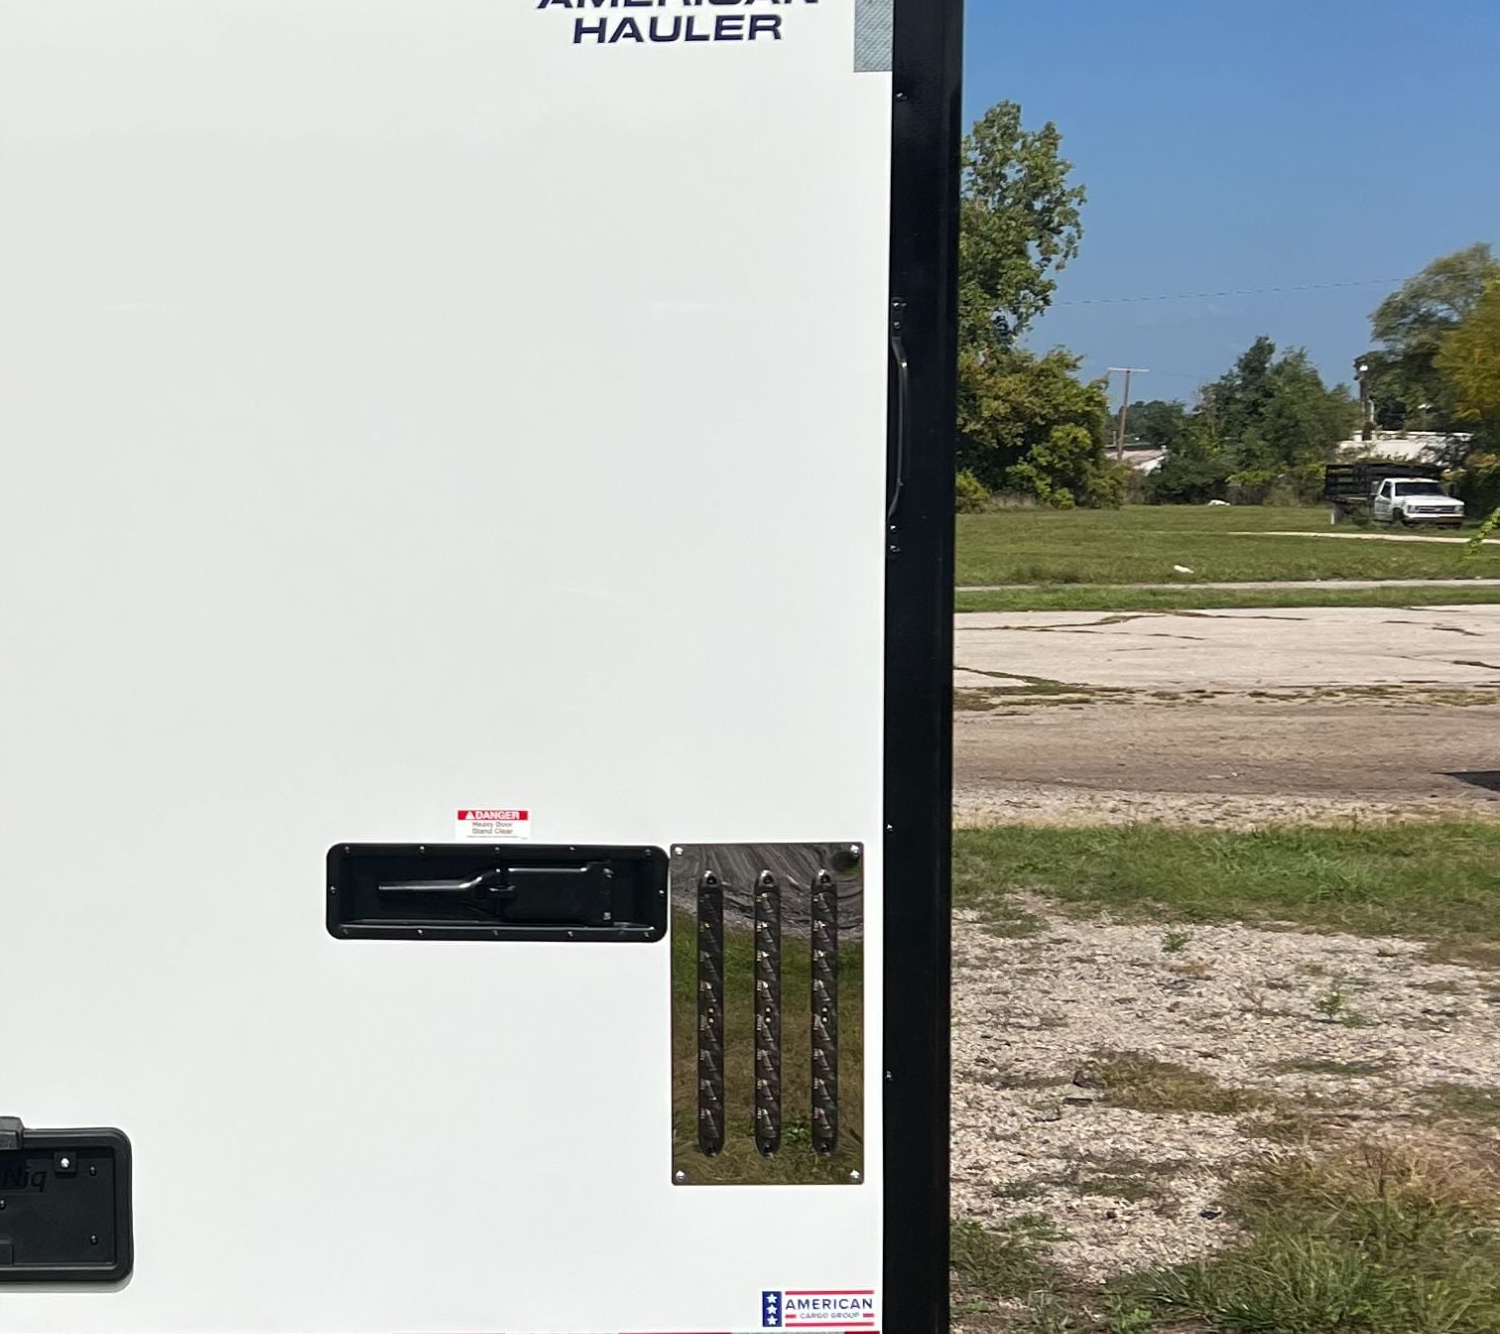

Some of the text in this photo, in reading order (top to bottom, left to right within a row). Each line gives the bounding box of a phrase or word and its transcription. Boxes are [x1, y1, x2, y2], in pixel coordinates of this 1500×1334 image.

[572, 14, 783, 45] HAULER
[476, 810, 520, 820] DANGER
[785, 1298, 873, 1310] AMERICAN
